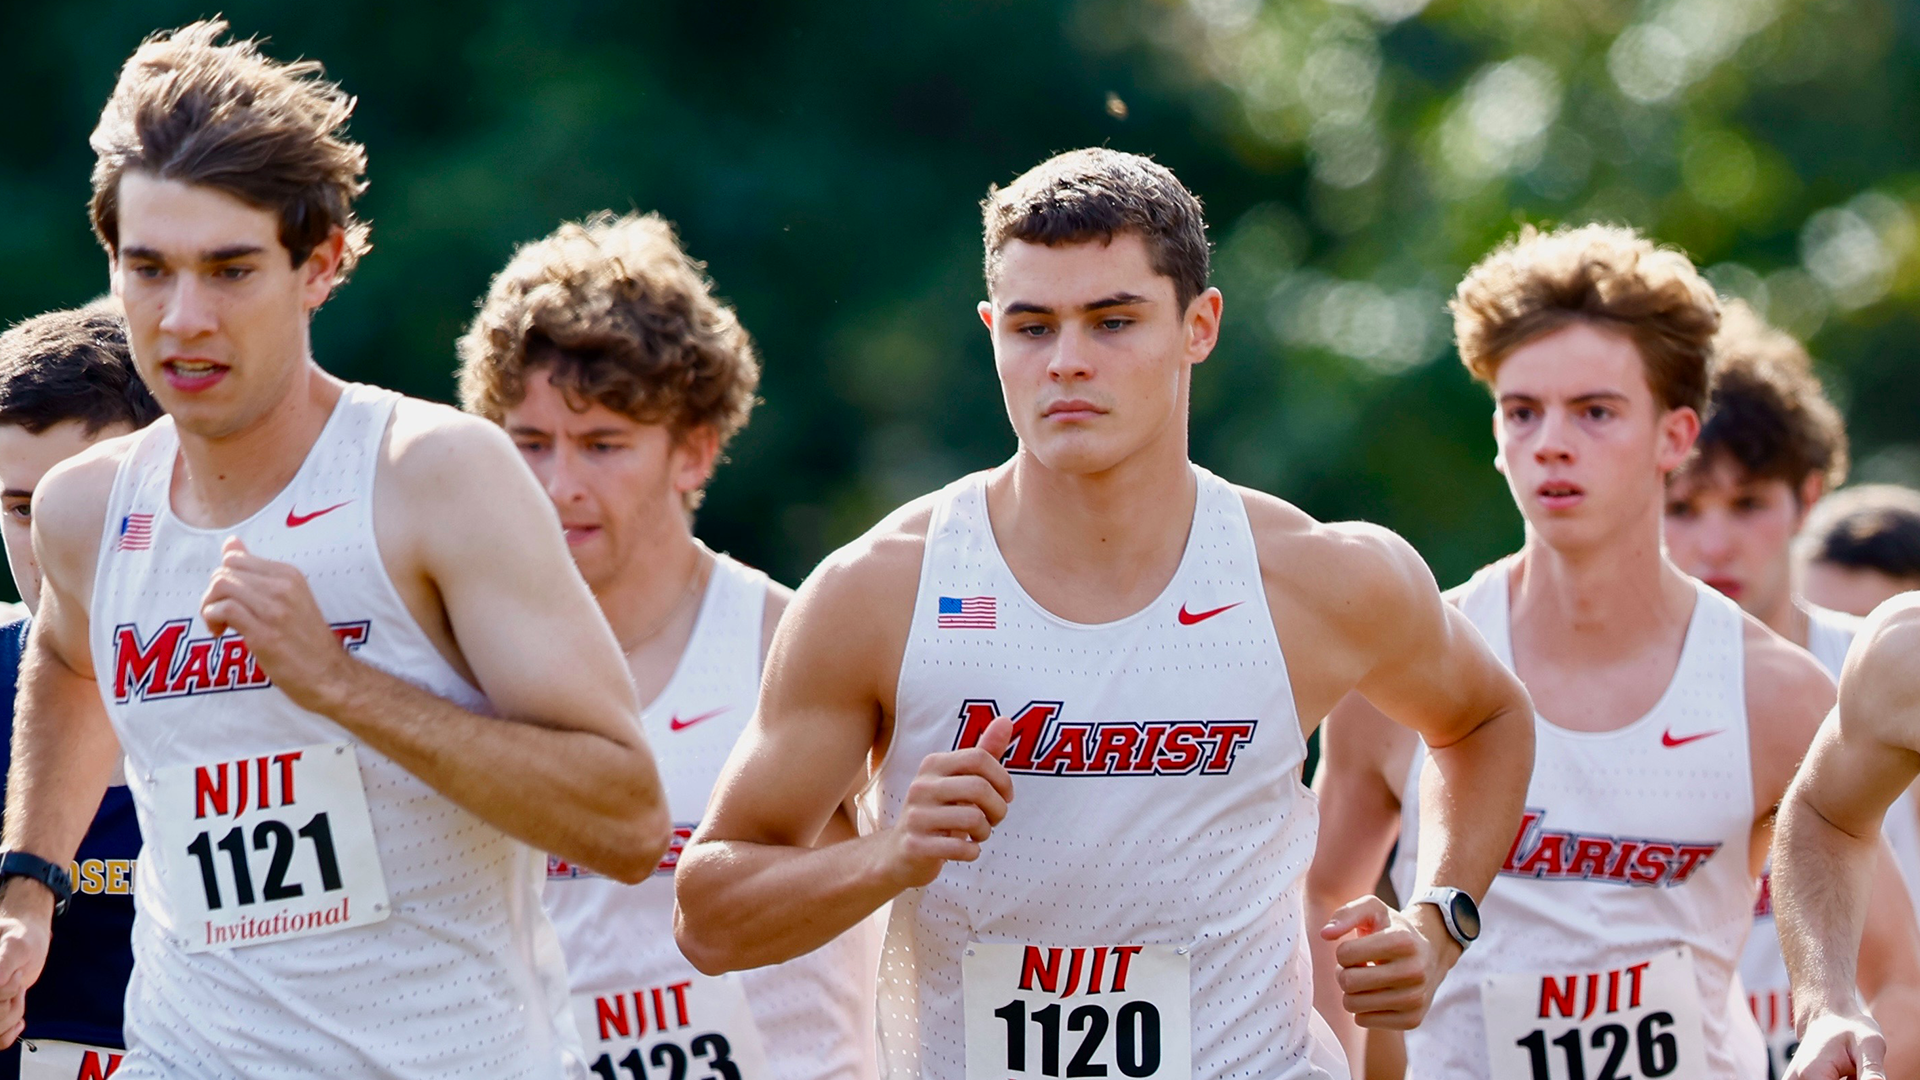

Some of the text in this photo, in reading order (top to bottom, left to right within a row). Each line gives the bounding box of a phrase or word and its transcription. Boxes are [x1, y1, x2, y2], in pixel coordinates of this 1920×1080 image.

[114, 618, 371, 704] MAR
[953, 699, 1258, 777] MARIST
[194, 751, 303, 820] NJIT
[186, 811, 343, 911] 1121
[205, 897, 350, 945] Invitational
[1017, 945, 1144, 999] NJIT
[1538, 961, 1651, 1022] NJIT
[594, 980, 692, 1042] NJIT
[994, 999, 1161, 1078] 1120
[1516, 1011, 1678, 1080] 1126
